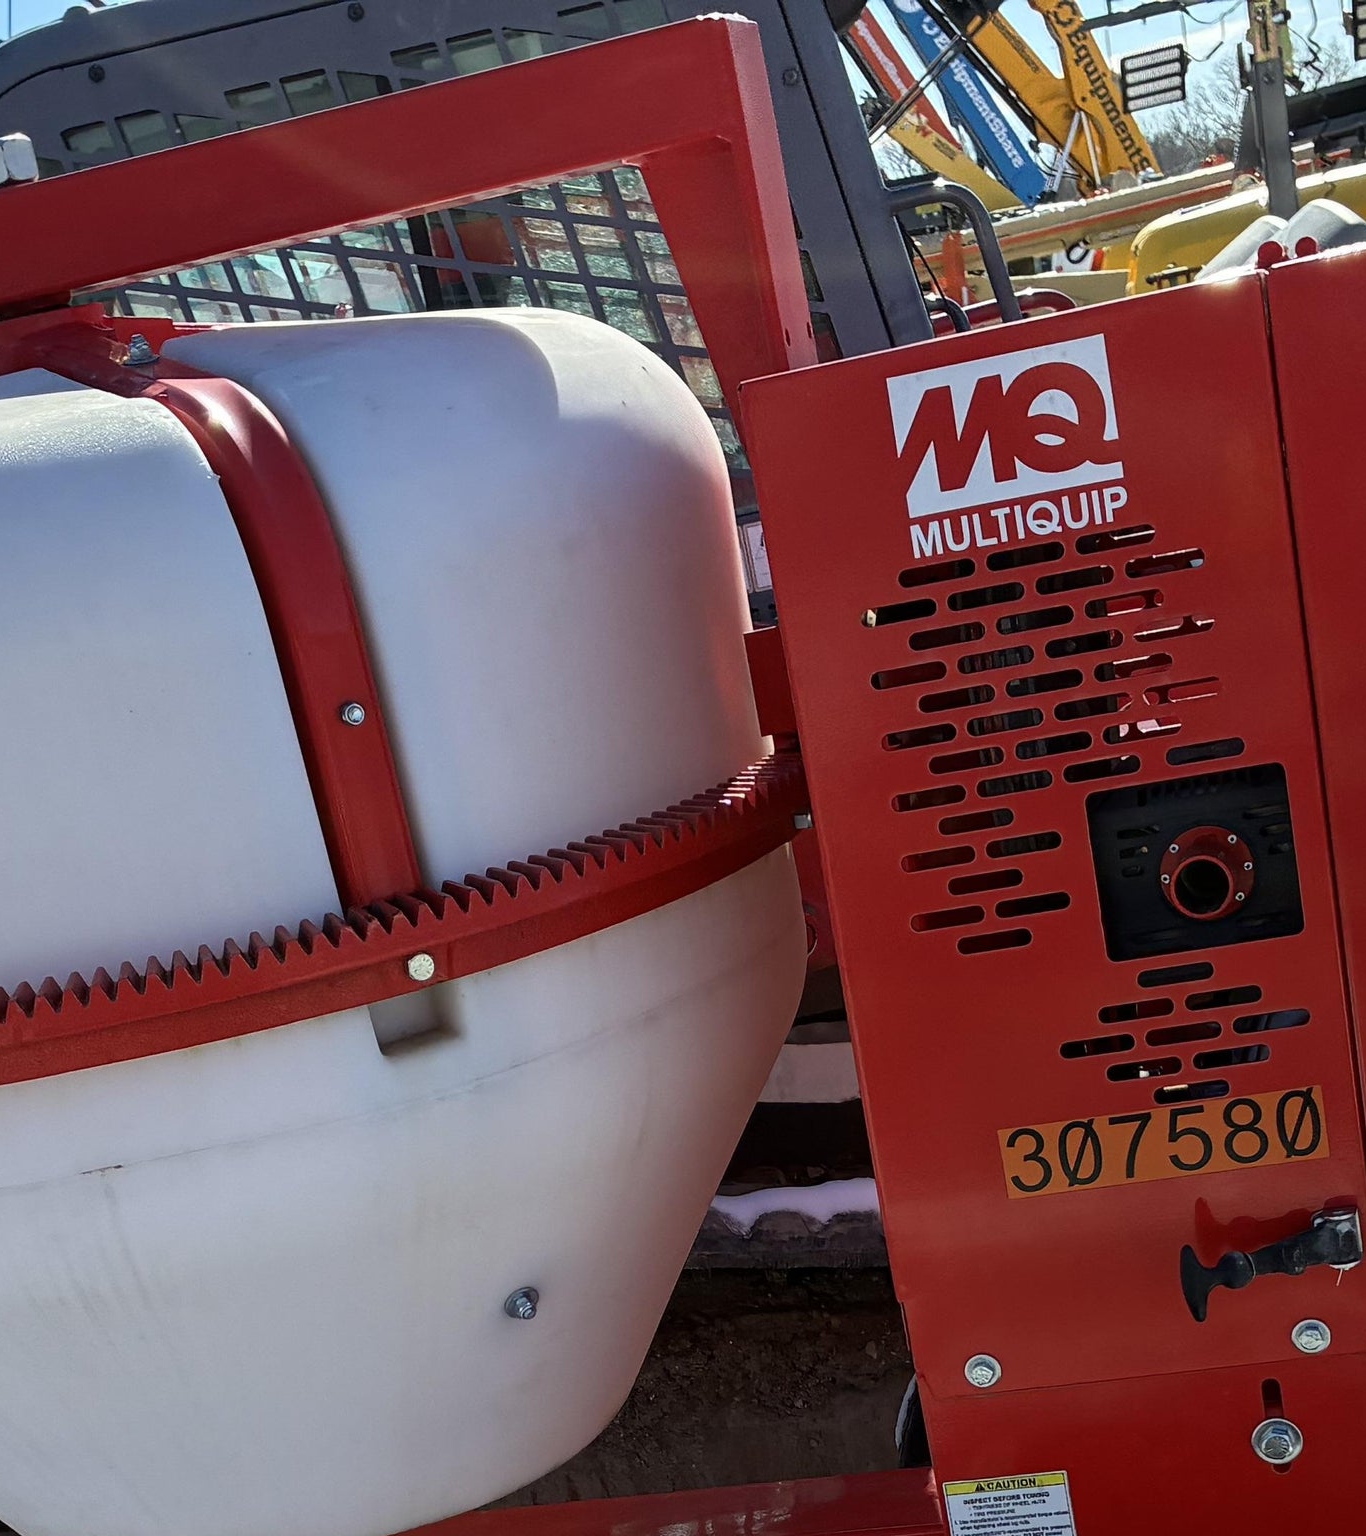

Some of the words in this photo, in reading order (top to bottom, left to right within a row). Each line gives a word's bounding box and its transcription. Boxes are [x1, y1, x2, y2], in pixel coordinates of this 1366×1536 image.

[897, 361, 1123, 492] MQ
[909, 485, 1128, 559] MULTIQUIP
[1005, 1086, 1324, 1193] 307580
[985, 1477, 1037, 1491] CAUTION
